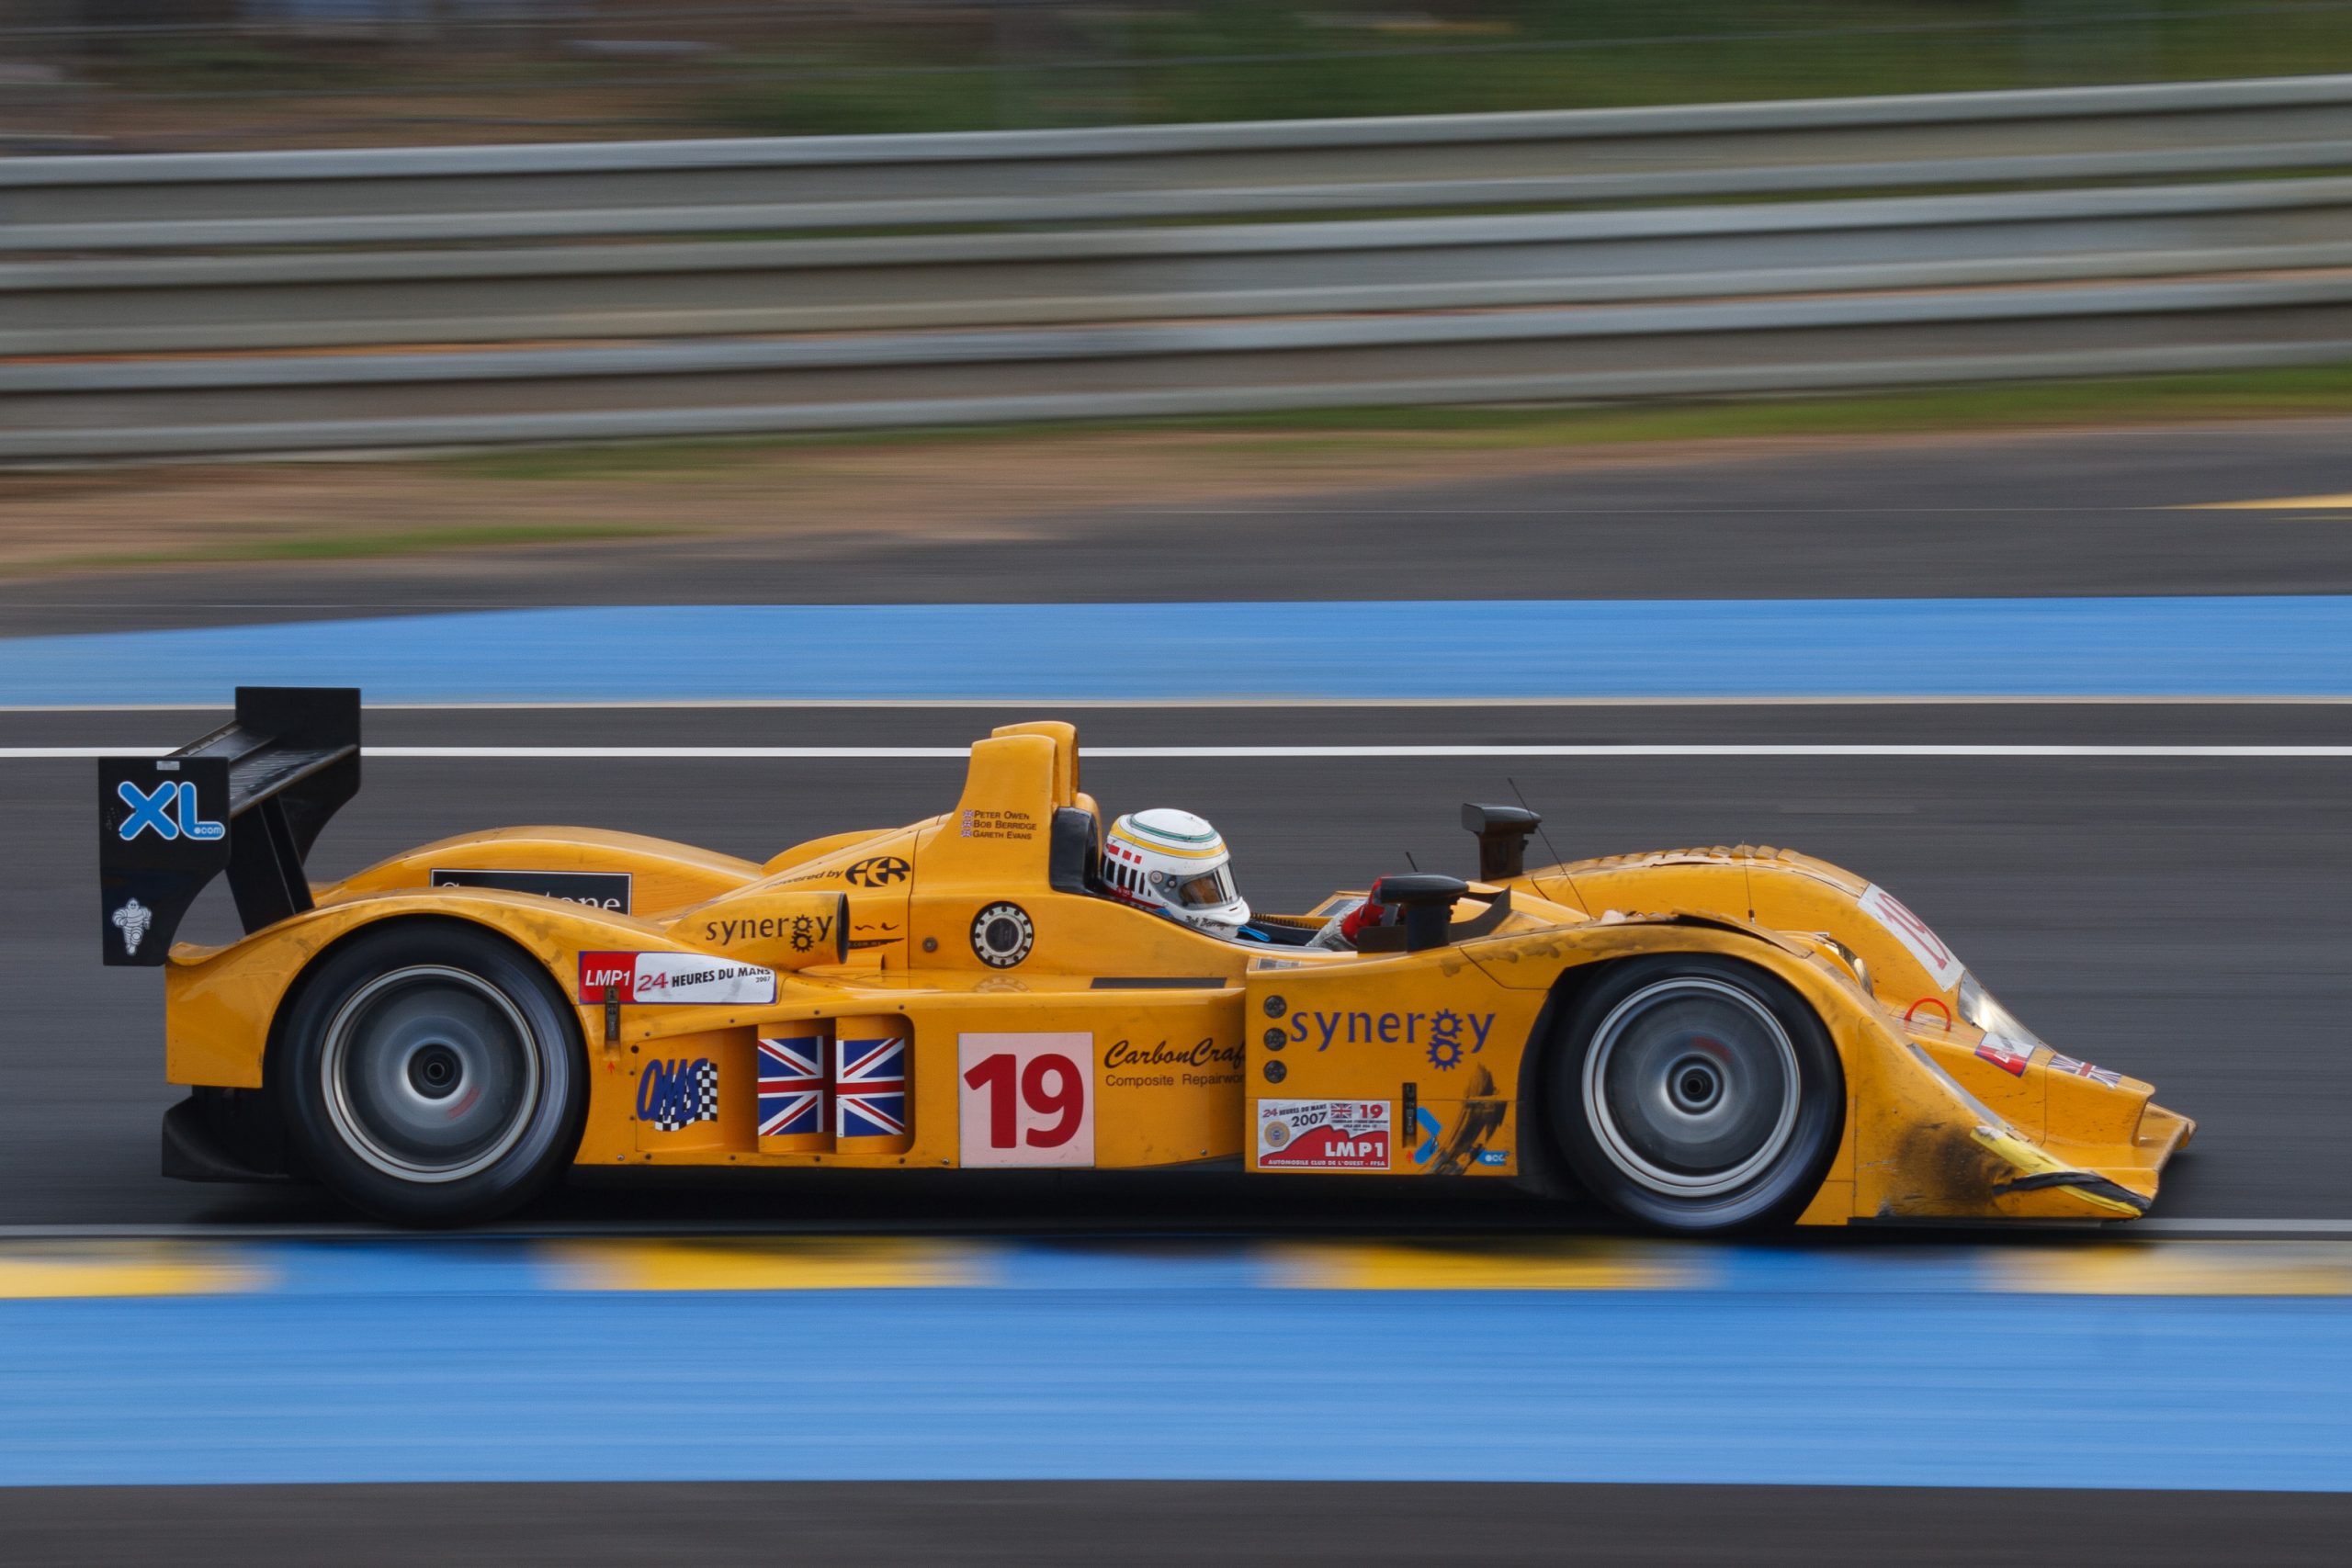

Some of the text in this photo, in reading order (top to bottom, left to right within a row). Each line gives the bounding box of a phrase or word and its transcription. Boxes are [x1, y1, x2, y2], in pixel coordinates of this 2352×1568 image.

[974, 810, 1030, 820] PETER OWEN
[974, 820, 992, 829] BOB
[1007, 831, 1032, 840] EVANS
[827, 869, 843, 879] by
[706, 914, 834, 953] synergy
[585, 970, 631, 987] LMP1
[637, 967, 771, 993] 24 HEURES DU MANS
[1290, 1008, 1496, 1071] synergy
[1105, 1074, 1174, 1089] Composite
[637, 1057, 708, 1122] OMS
[964, 1054, 1084, 1148] 19
[1262, 1108, 1278, 1118] 24
[1361, 1104, 1384, 1119] 19
[1291, 1111, 1328, 1128] 2007
[1325, 1142, 1384, 1157] LMP1
